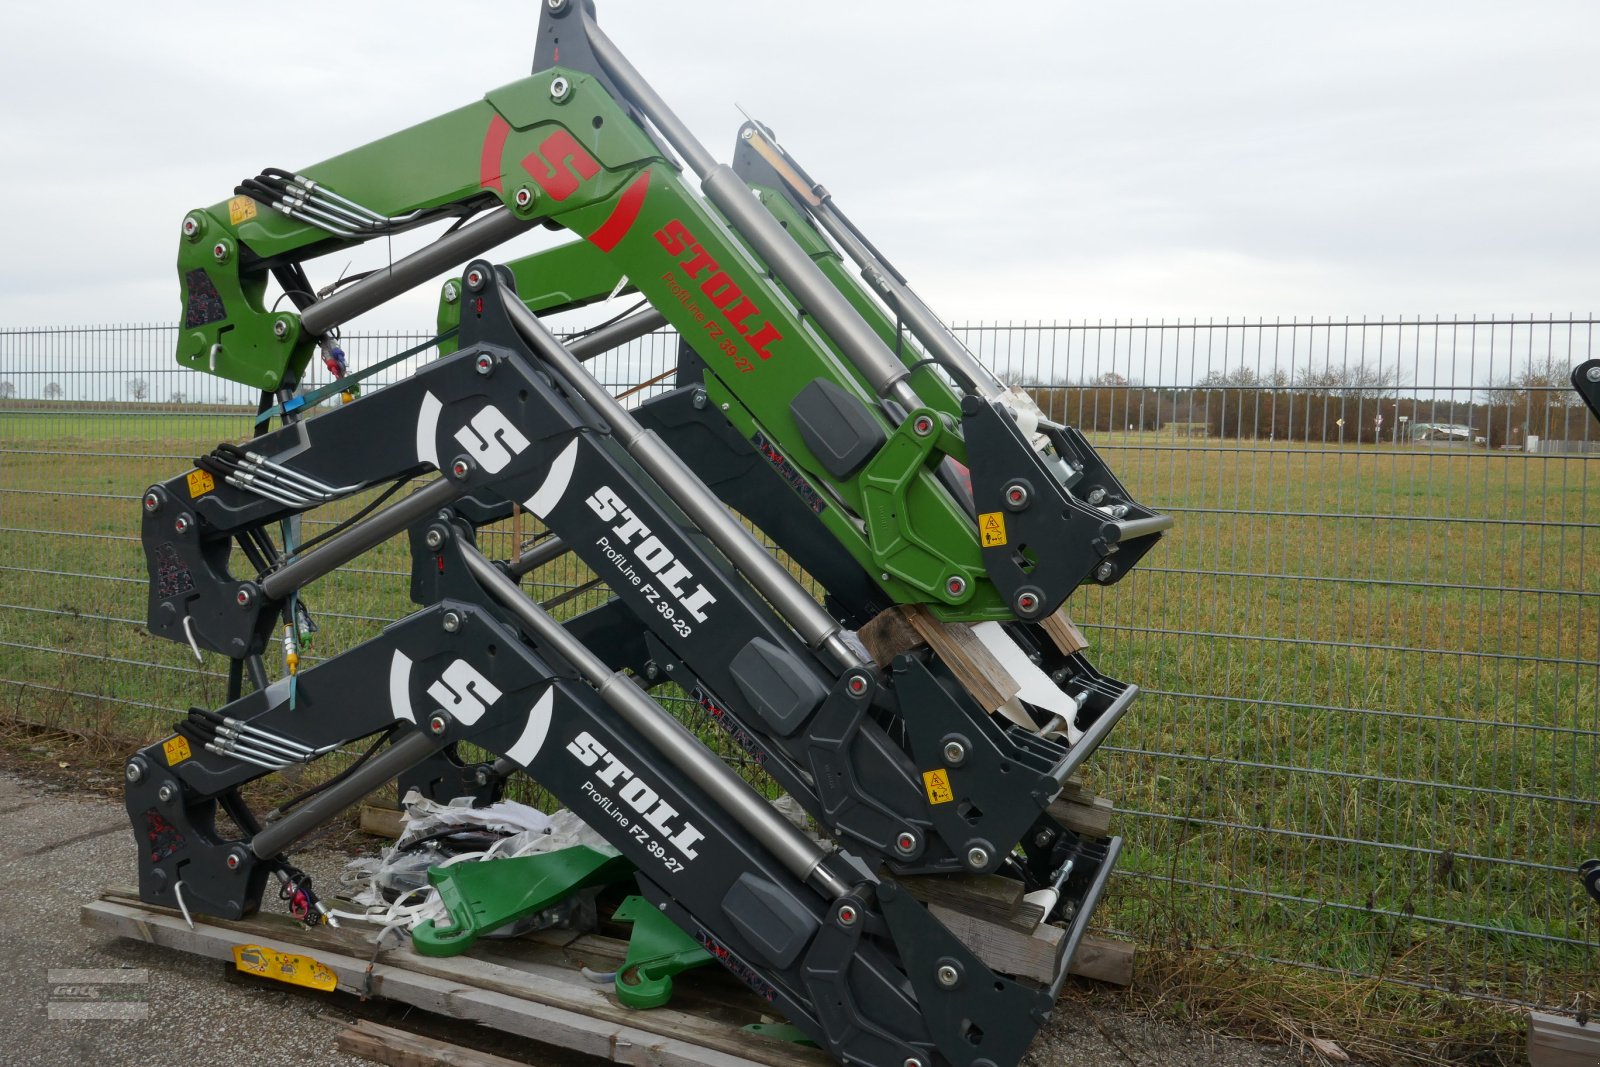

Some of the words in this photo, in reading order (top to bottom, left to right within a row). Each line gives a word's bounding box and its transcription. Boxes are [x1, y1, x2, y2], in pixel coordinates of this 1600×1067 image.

[652, 218, 783, 361] STOLL
[661, 271, 705, 323] ProfiLine
[704, 320, 724, 341] FZ
[719, 337, 755, 373] 39-27
[585, 485, 717, 624] STOLL
[595, 536, 642, 586] ProfiLine
[639, 583, 661, 604] FZ
[656, 601, 692, 638] 39-23
[566, 731, 706, 861] STOLL
[580, 780, 629, 828] ProfiLine
[628, 823, 650, 844] FZ
[647, 840, 685, 873] 39-27
